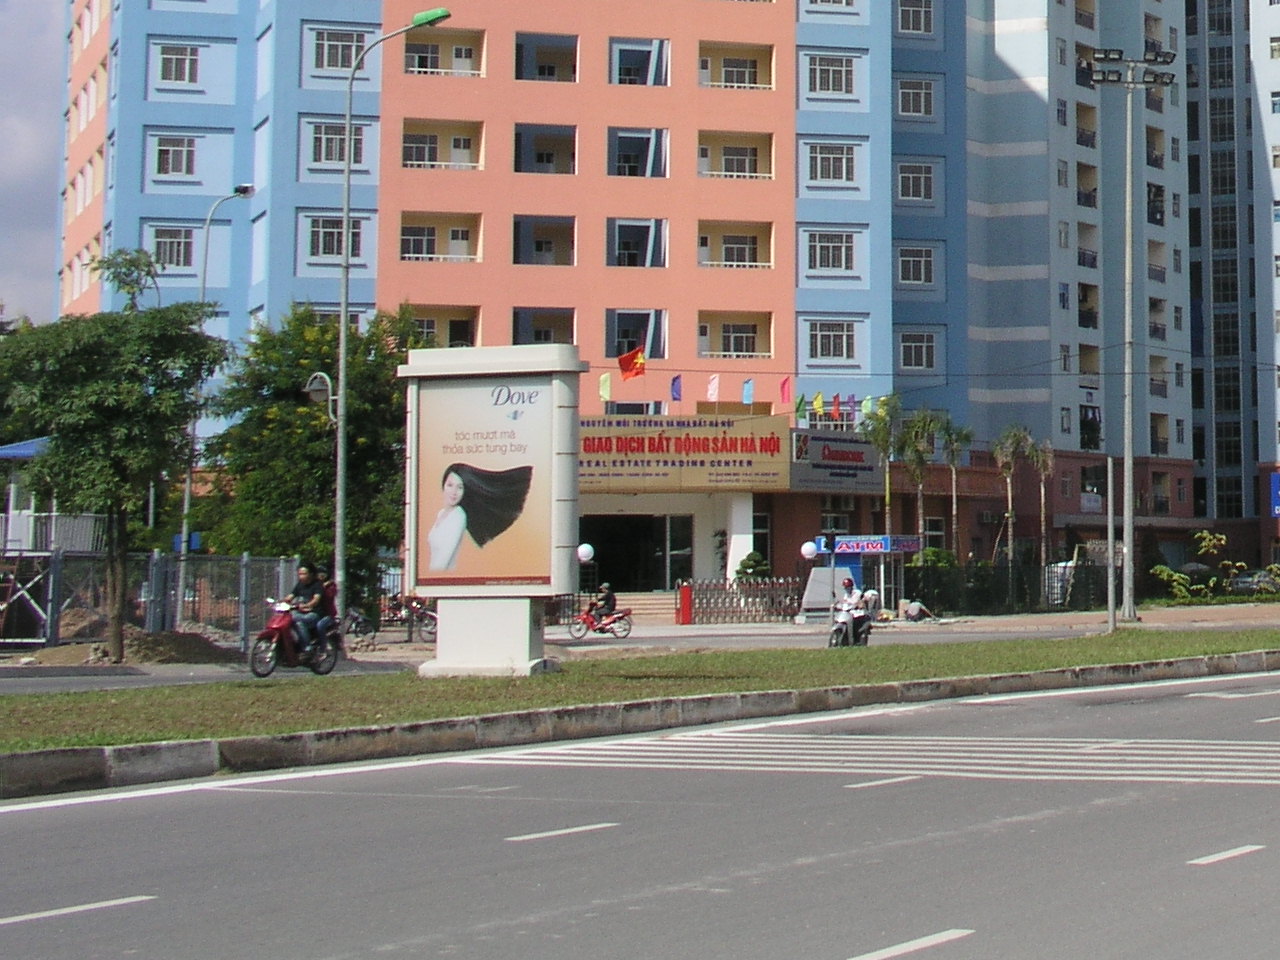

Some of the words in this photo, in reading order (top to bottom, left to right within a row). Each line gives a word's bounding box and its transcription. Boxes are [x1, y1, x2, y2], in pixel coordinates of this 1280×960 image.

[491, 384, 541, 406] Dove
[583, 436, 612, 453] GIAO
[616, 436, 645, 456] DỊCH
[648, 429, 672, 453] BẤT
[674, 433, 709, 456] ĐỘNG
[711, 430, 738, 453] SẢN
[741, 431, 757, 453] HÀ
[760, 431, 780, 457] NỘI
[710, 460, 752, 468] CENTER
[838, 541, 883, 551] ATM
